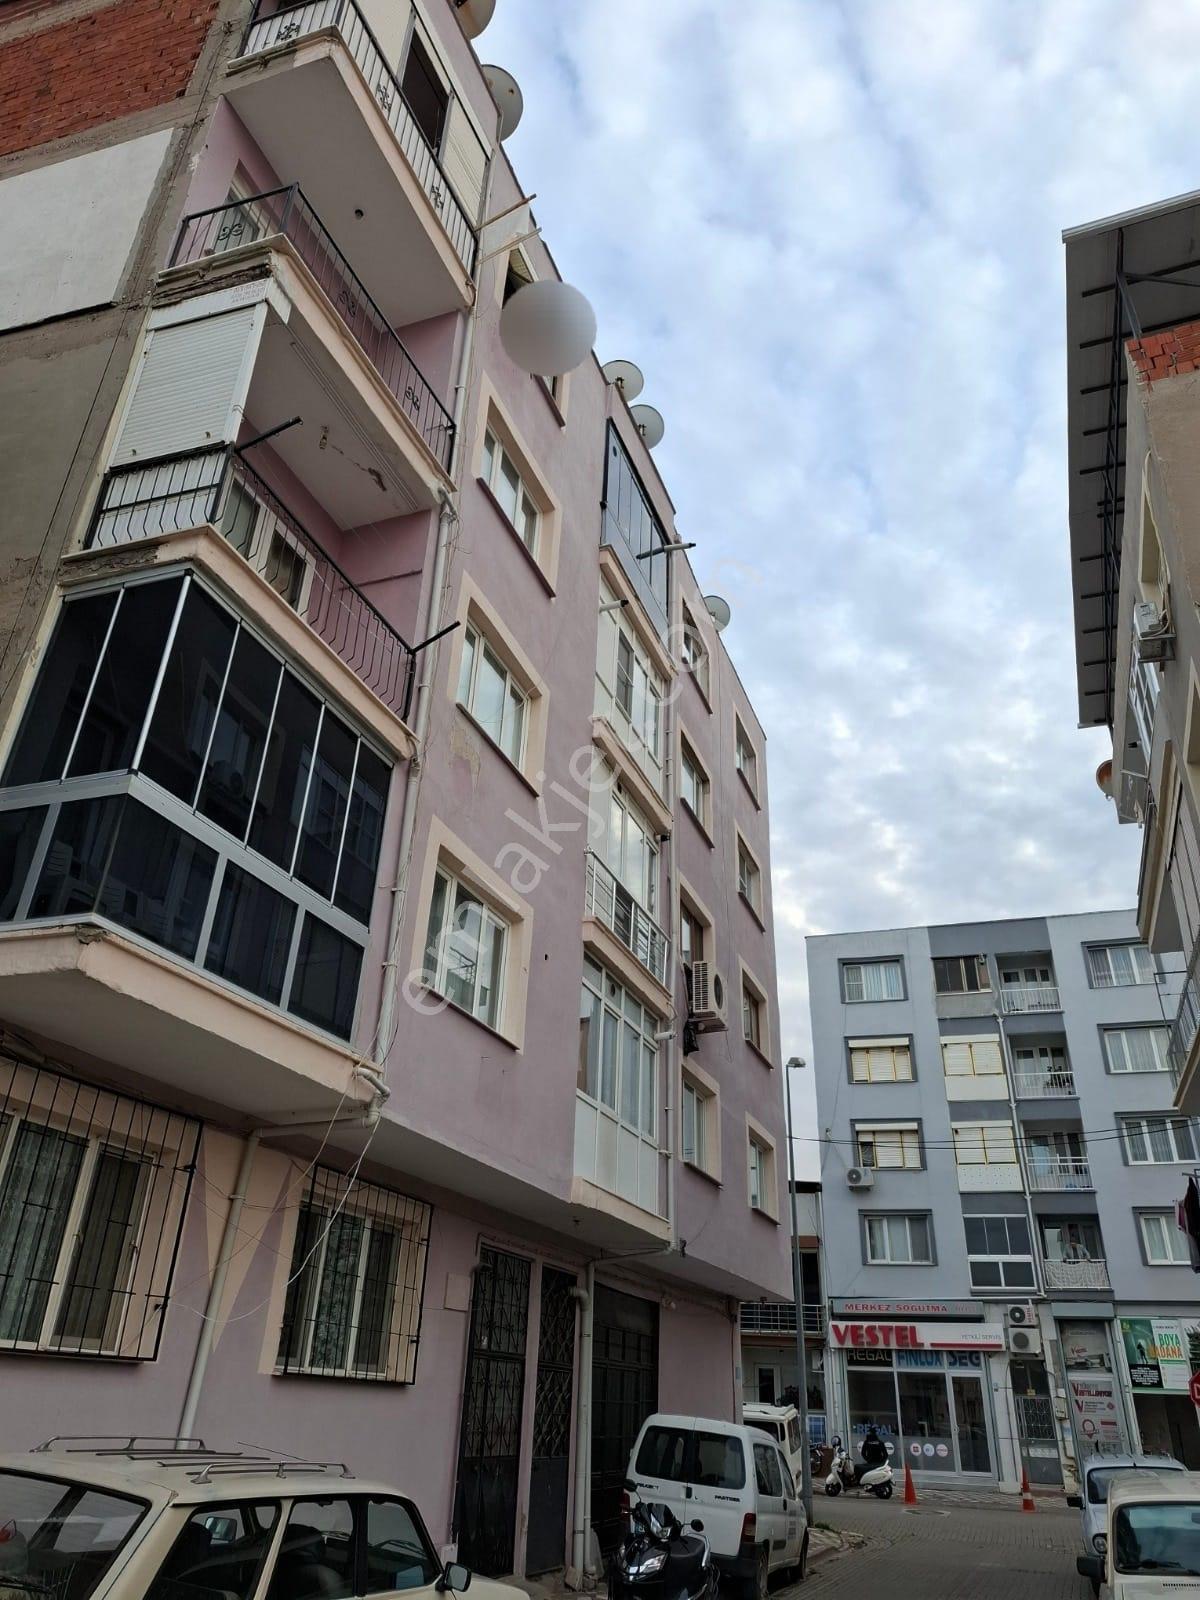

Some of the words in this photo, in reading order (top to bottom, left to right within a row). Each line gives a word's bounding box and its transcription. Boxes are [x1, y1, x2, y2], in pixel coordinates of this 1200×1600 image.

[845, 1303, 891, 1312] MERKEZ
[832, 1324, 925, 1348] VESTEL
[1158, 1333, 1181, 1346] BOYA
[847, 1349, 893, 1361] REGAL
[897, 1350, 943, 1367] FINLUX
[948, 1351, 981, 1367] SEG
